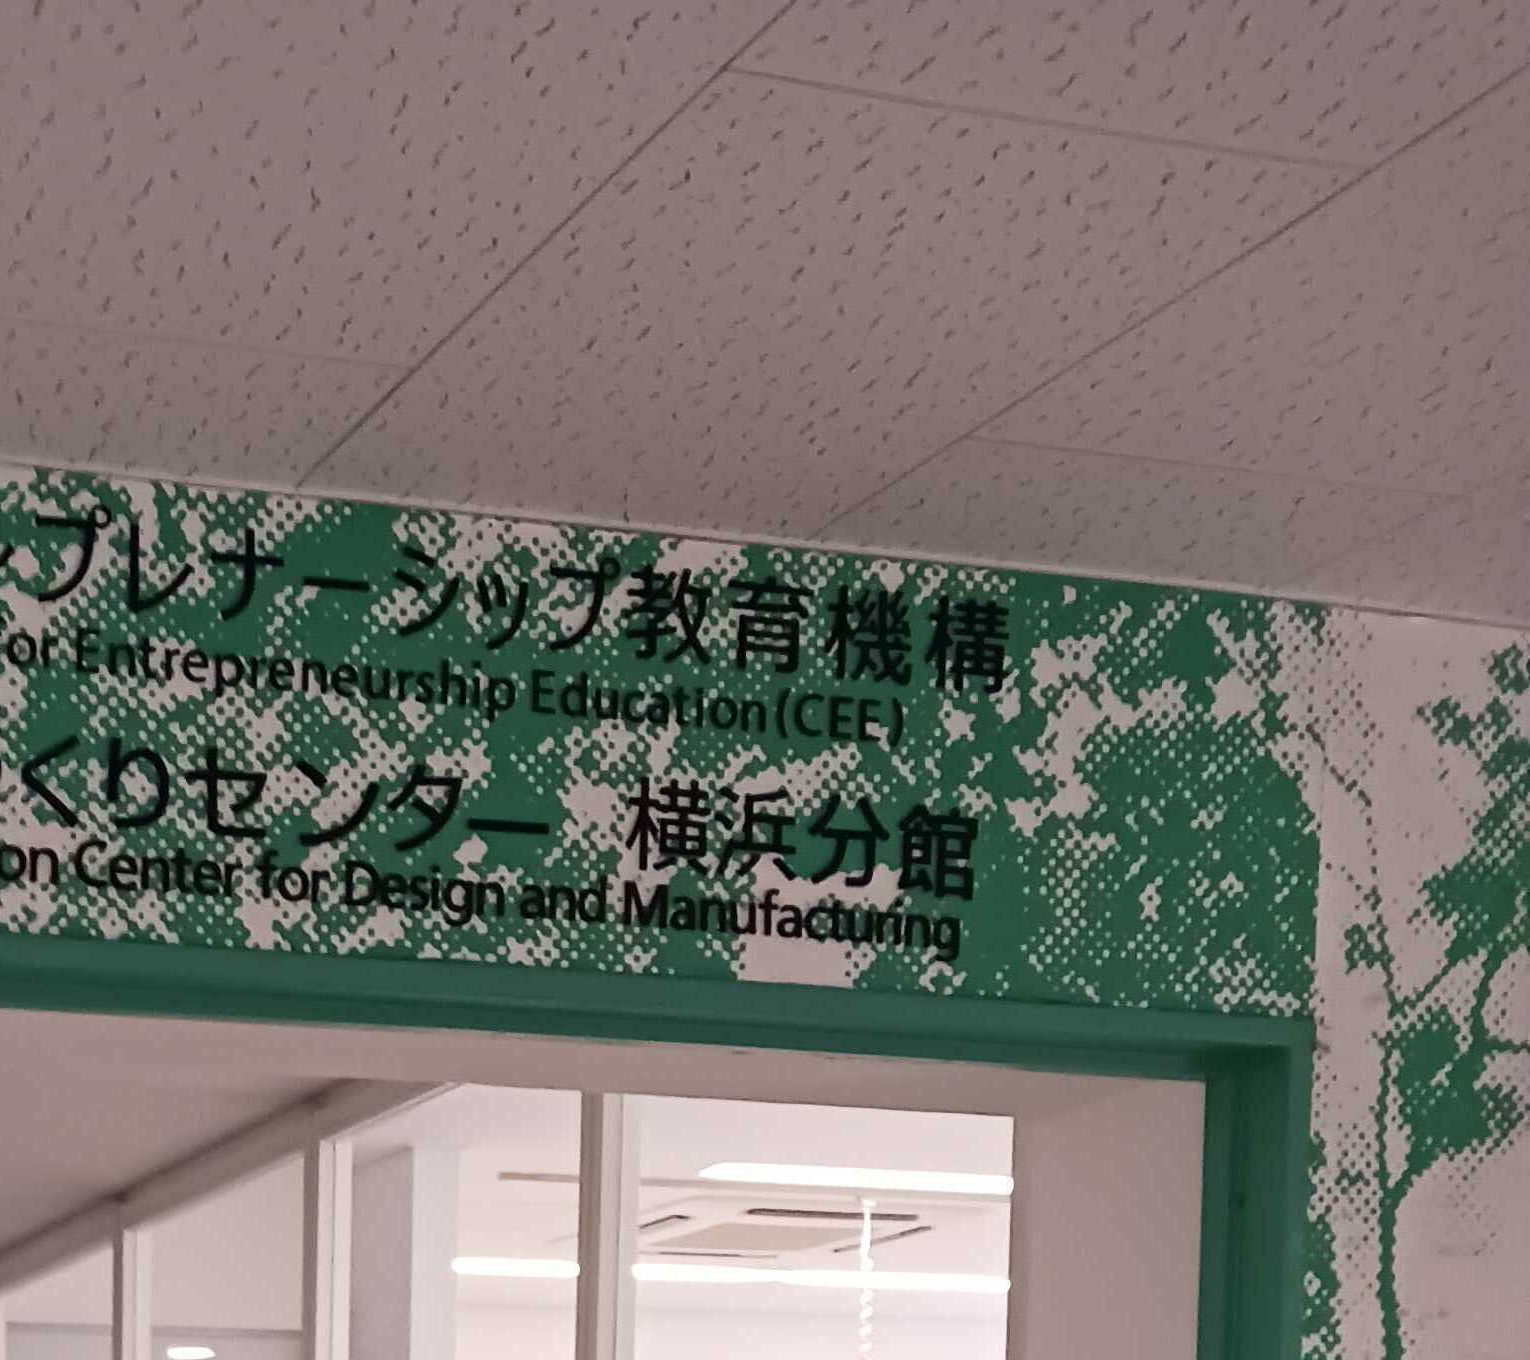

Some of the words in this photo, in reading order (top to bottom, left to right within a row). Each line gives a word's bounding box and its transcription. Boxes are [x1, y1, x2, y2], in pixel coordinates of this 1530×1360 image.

[75, 628, 516, 722] Entrepreneurship
[627, 775, 979, 901] 横浜分館
[75, 840, 243, 896] Center
[262, 850, 329, 901] for
[344, 860, 504, 928] Design
[521, 882, 607, 924] and
[623, 882, 962, 962] Manufacturing
